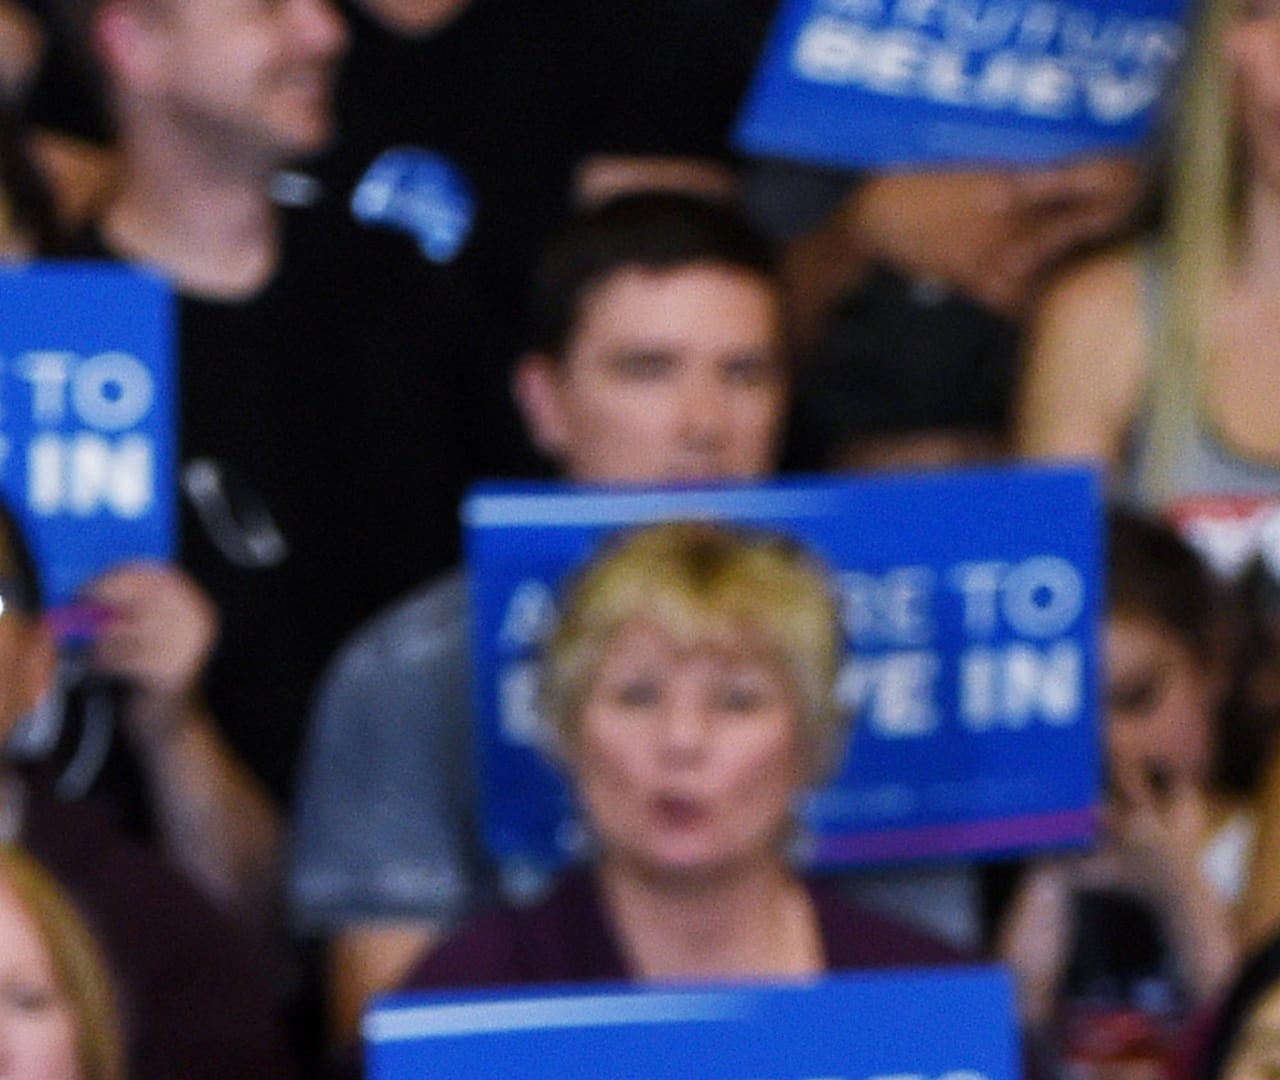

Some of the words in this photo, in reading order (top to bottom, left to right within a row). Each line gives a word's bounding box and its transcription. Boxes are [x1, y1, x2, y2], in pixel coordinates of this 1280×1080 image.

[8, 348, 155, 432] TO
[25, 432, 155, 520] IN
[944, 554, 1085, 639] TO
[957, 638, 1083, 734] IN
